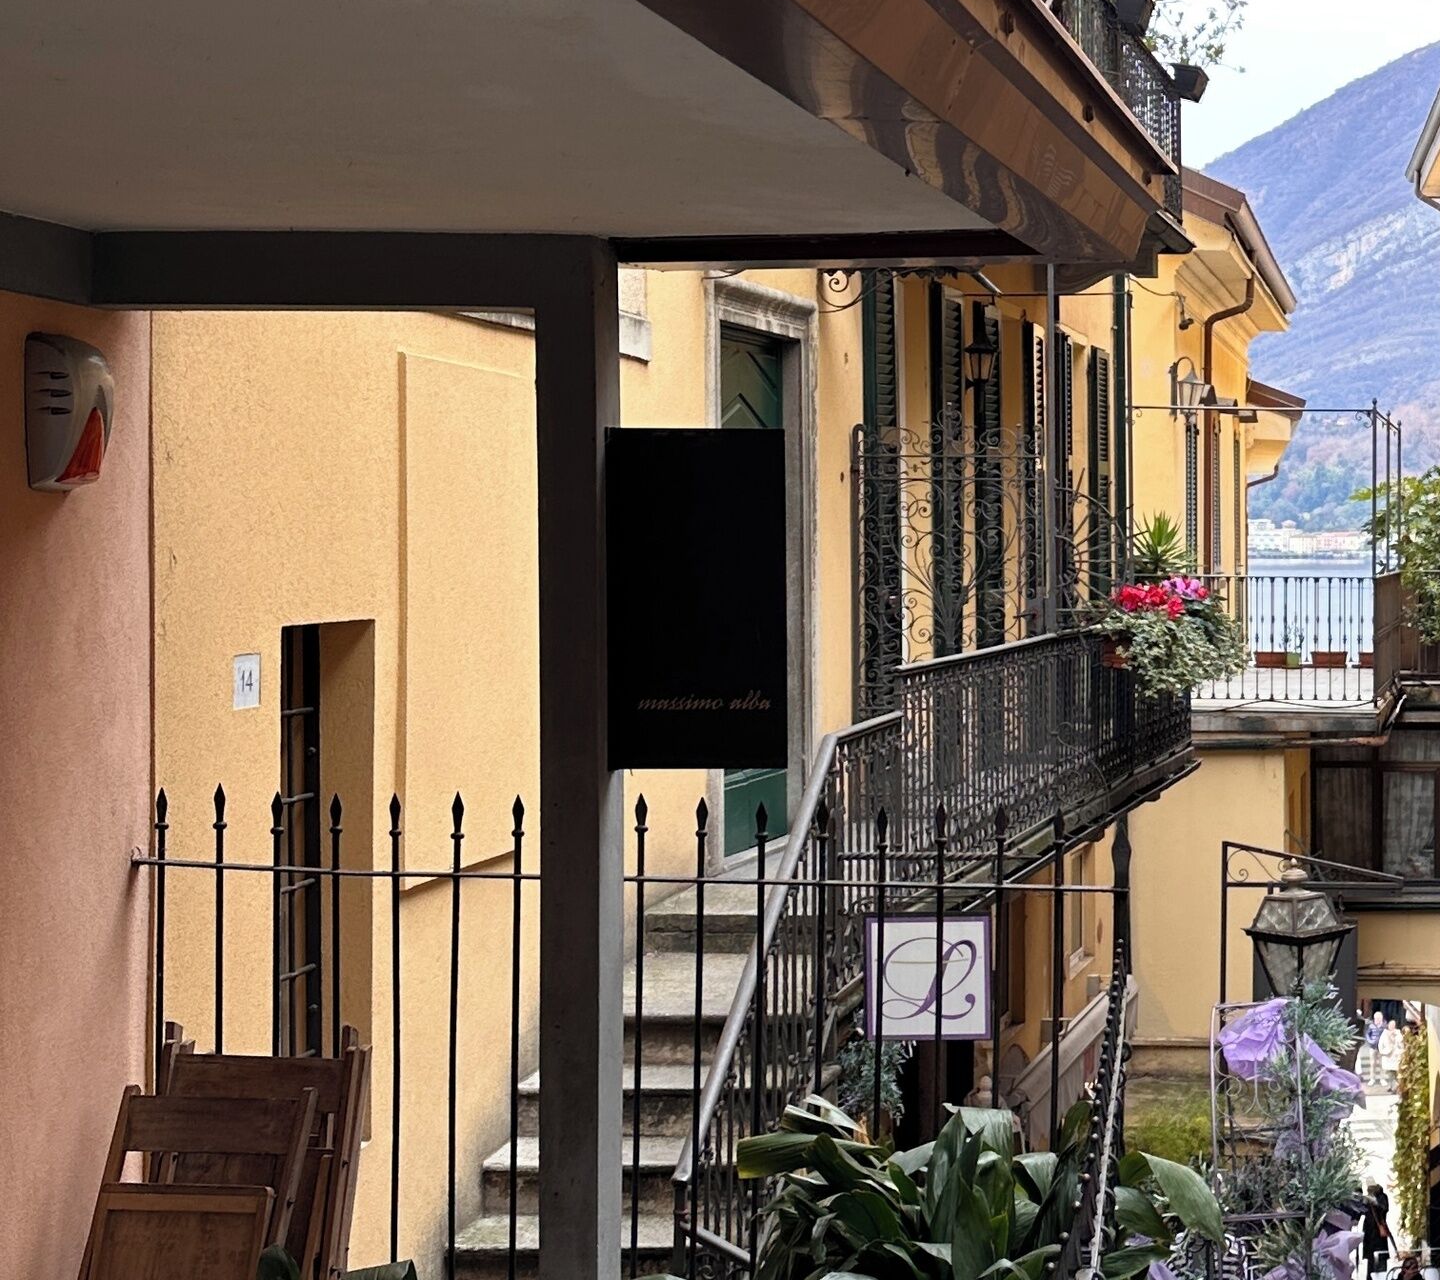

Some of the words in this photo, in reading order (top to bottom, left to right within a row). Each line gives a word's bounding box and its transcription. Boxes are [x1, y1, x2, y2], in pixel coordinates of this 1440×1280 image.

[240, 669, 254, 693] 14
[637, 693, 725, 710] massimo
[729, 689, 771, 710] alba
